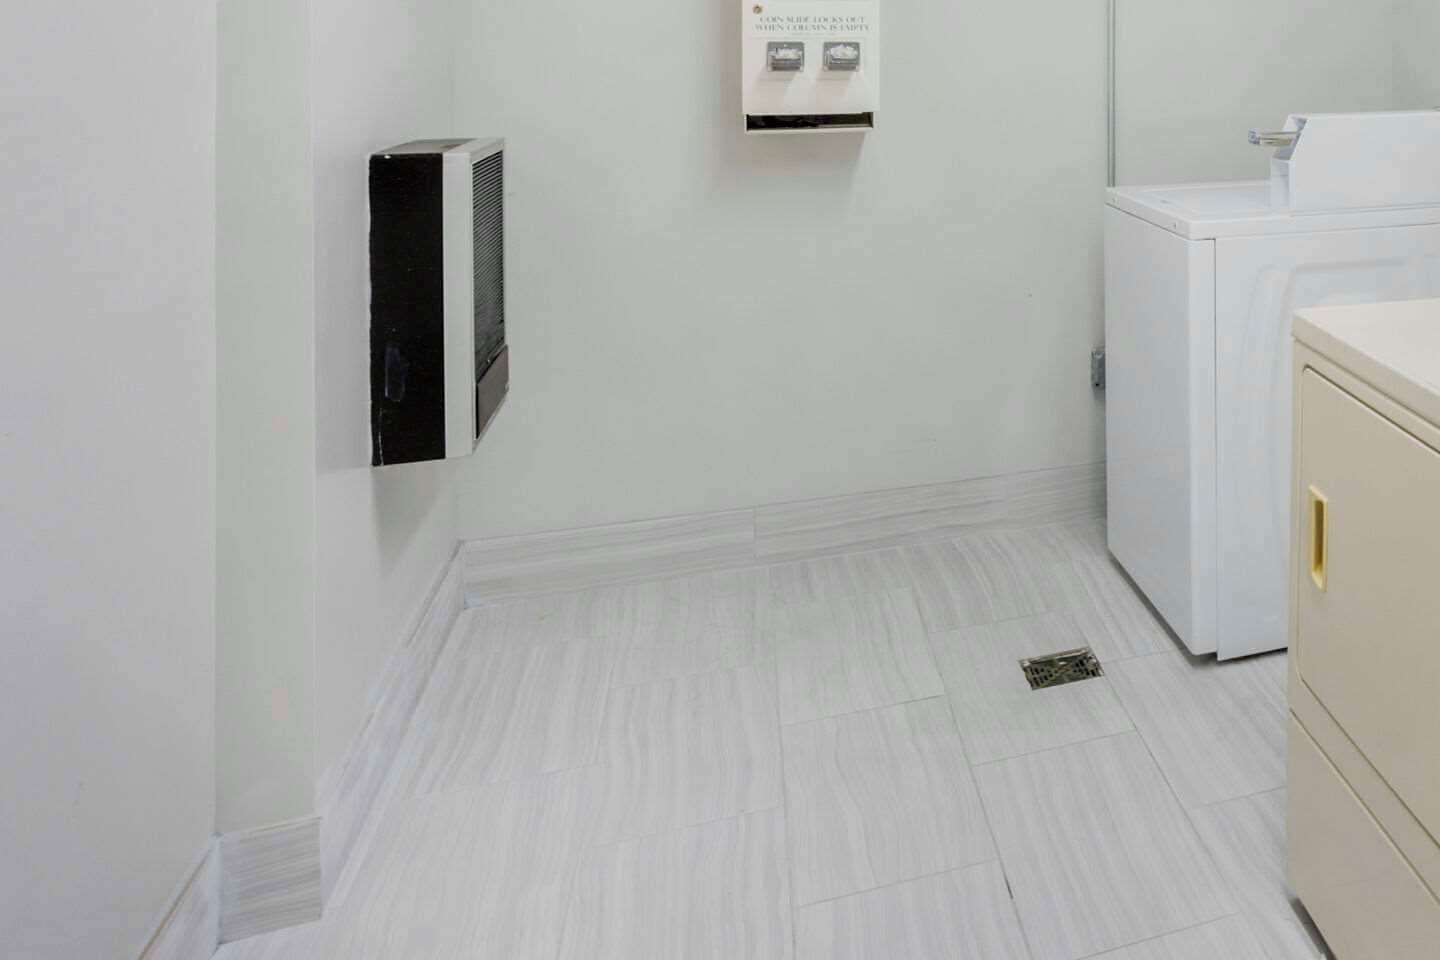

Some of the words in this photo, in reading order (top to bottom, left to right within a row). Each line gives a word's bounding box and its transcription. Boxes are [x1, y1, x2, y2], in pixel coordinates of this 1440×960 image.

[759, 15, 784, 23] COIN
[813, 15, 844, 23] LOCKS
[787, 23, 827, 31] COLUMN
[830, 23, 837, 31] IS
